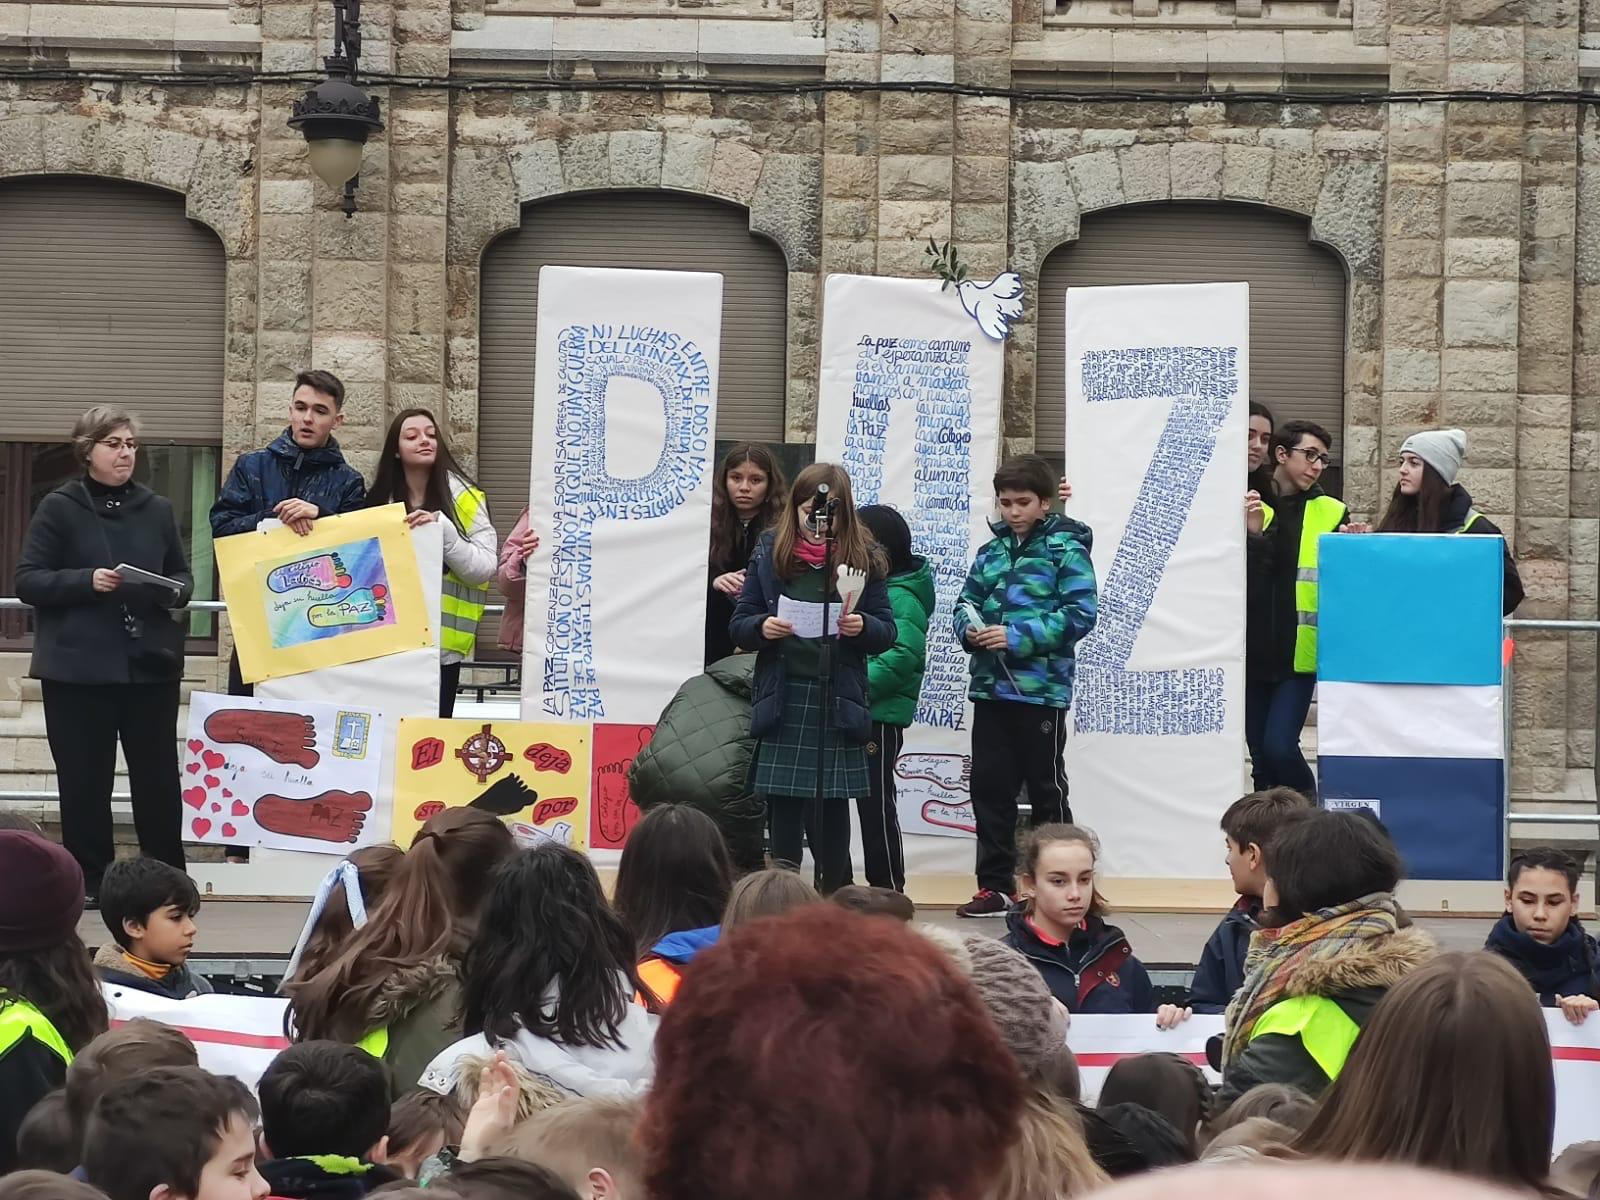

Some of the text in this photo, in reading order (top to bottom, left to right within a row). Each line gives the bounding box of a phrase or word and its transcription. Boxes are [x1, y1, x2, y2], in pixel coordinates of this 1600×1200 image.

[592, 324, 612, 339] NI
[618, 325, 681, 350] LUCHAS
[567, 325, 588, 385] GUERRA
[589, 340, 623, 354] DEL
[875, 338, 898, 354] paz
[899, 339, 928, 349] como
[928, 339, 972, 352] camino
[681, 341, 709, 397] ENTRE
[558, 383, 566, 394] DE
[567, 387, 584, 416] HAY
[567, 420, 582, 446] NO
[679, 387, 692, 456] DEFINIDA
[692, 404, 709, 436] DOS
[692, 439, 707, 451] O
[554, 440, 567, 506] SONRISA
[566, 452, 582, 489] QUE
[673, 456, 687, 477] EN
[621, 477, 675, 504] SENTIDO
[564, 491, 577, 518] EN
[632, 489, 686, 520] PARTES
[553, 511, 563, 539] UNA
[551, 545, 560, 575] CON
[560, 522, 578, 589] ESTADO
[307, 591, 337, 600] huella
[337, 602, 372, 616] PAZ
[559, 594, 572, 607] O
[546, 577, 558, 654] COMIENZA
[569, 607, 586, 719] PLAN DE PAZ
[582, 600, 605, 719] TIEMPO DE PAZ
[543, 657, 554, 693] PAZ
[542, 698, 556, 716] LA
[926, 707, 937, 726] LA
[939, 709, 967, 731] PAZ
[526, 744, 571, 773] deja
[309, 804, 344, 827] PAZ
[538, 798, 574, 820] por
[954, 807, 973, 819] PA
